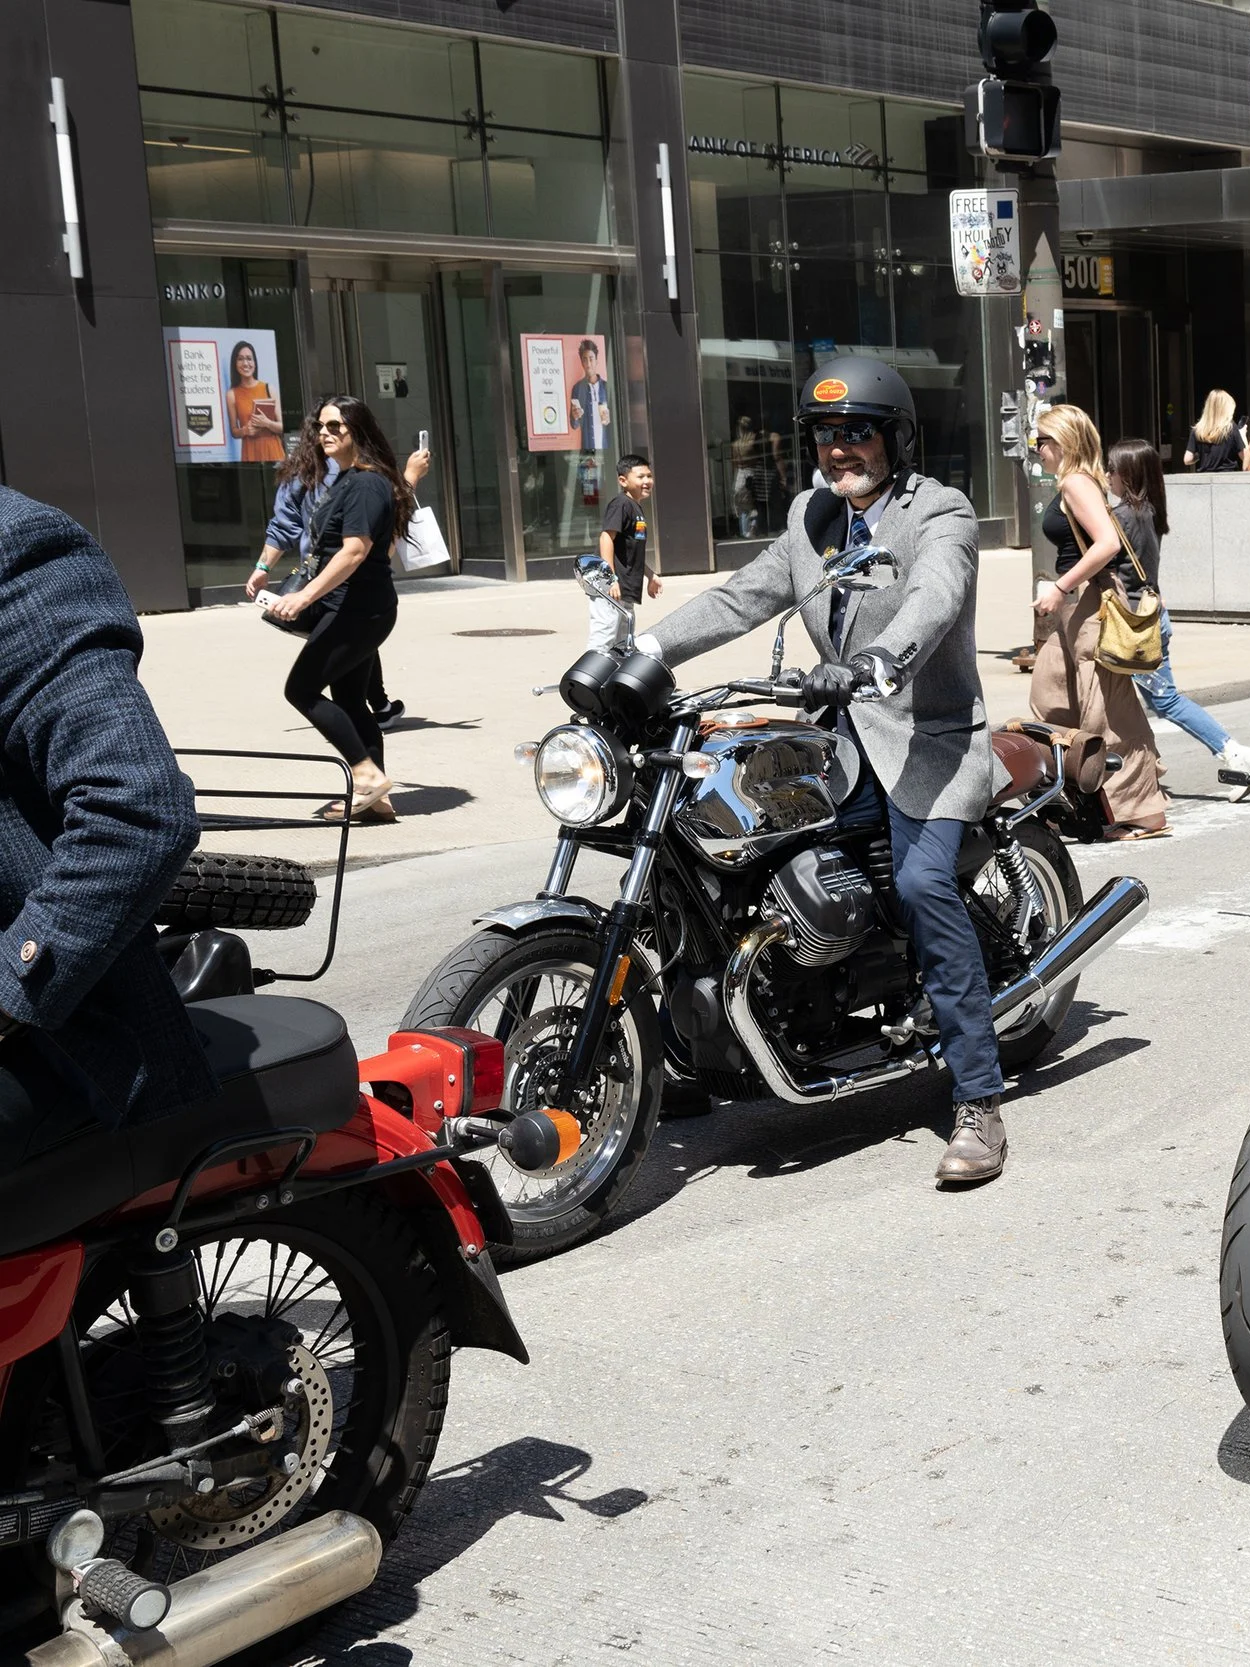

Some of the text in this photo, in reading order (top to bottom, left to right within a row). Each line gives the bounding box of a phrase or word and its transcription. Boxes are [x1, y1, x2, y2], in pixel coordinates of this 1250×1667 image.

[687, 135, 728, 154] ANK
[955, 198, 987, 213] FREE
[957, 227, 1012, 243] TROLLEY
[1064, 255, 1100, 290] 500
[164, 282, 226, 301] BANK O
[183, 350, 205, 360] Bank
[531, 346, 559, 354] Powerful
[179, 363, 212, 372] with the
[180, 374, 212, 383] best for
[180, 384, 216, 395] students
[618, 1039, 630, 1068] brembo
